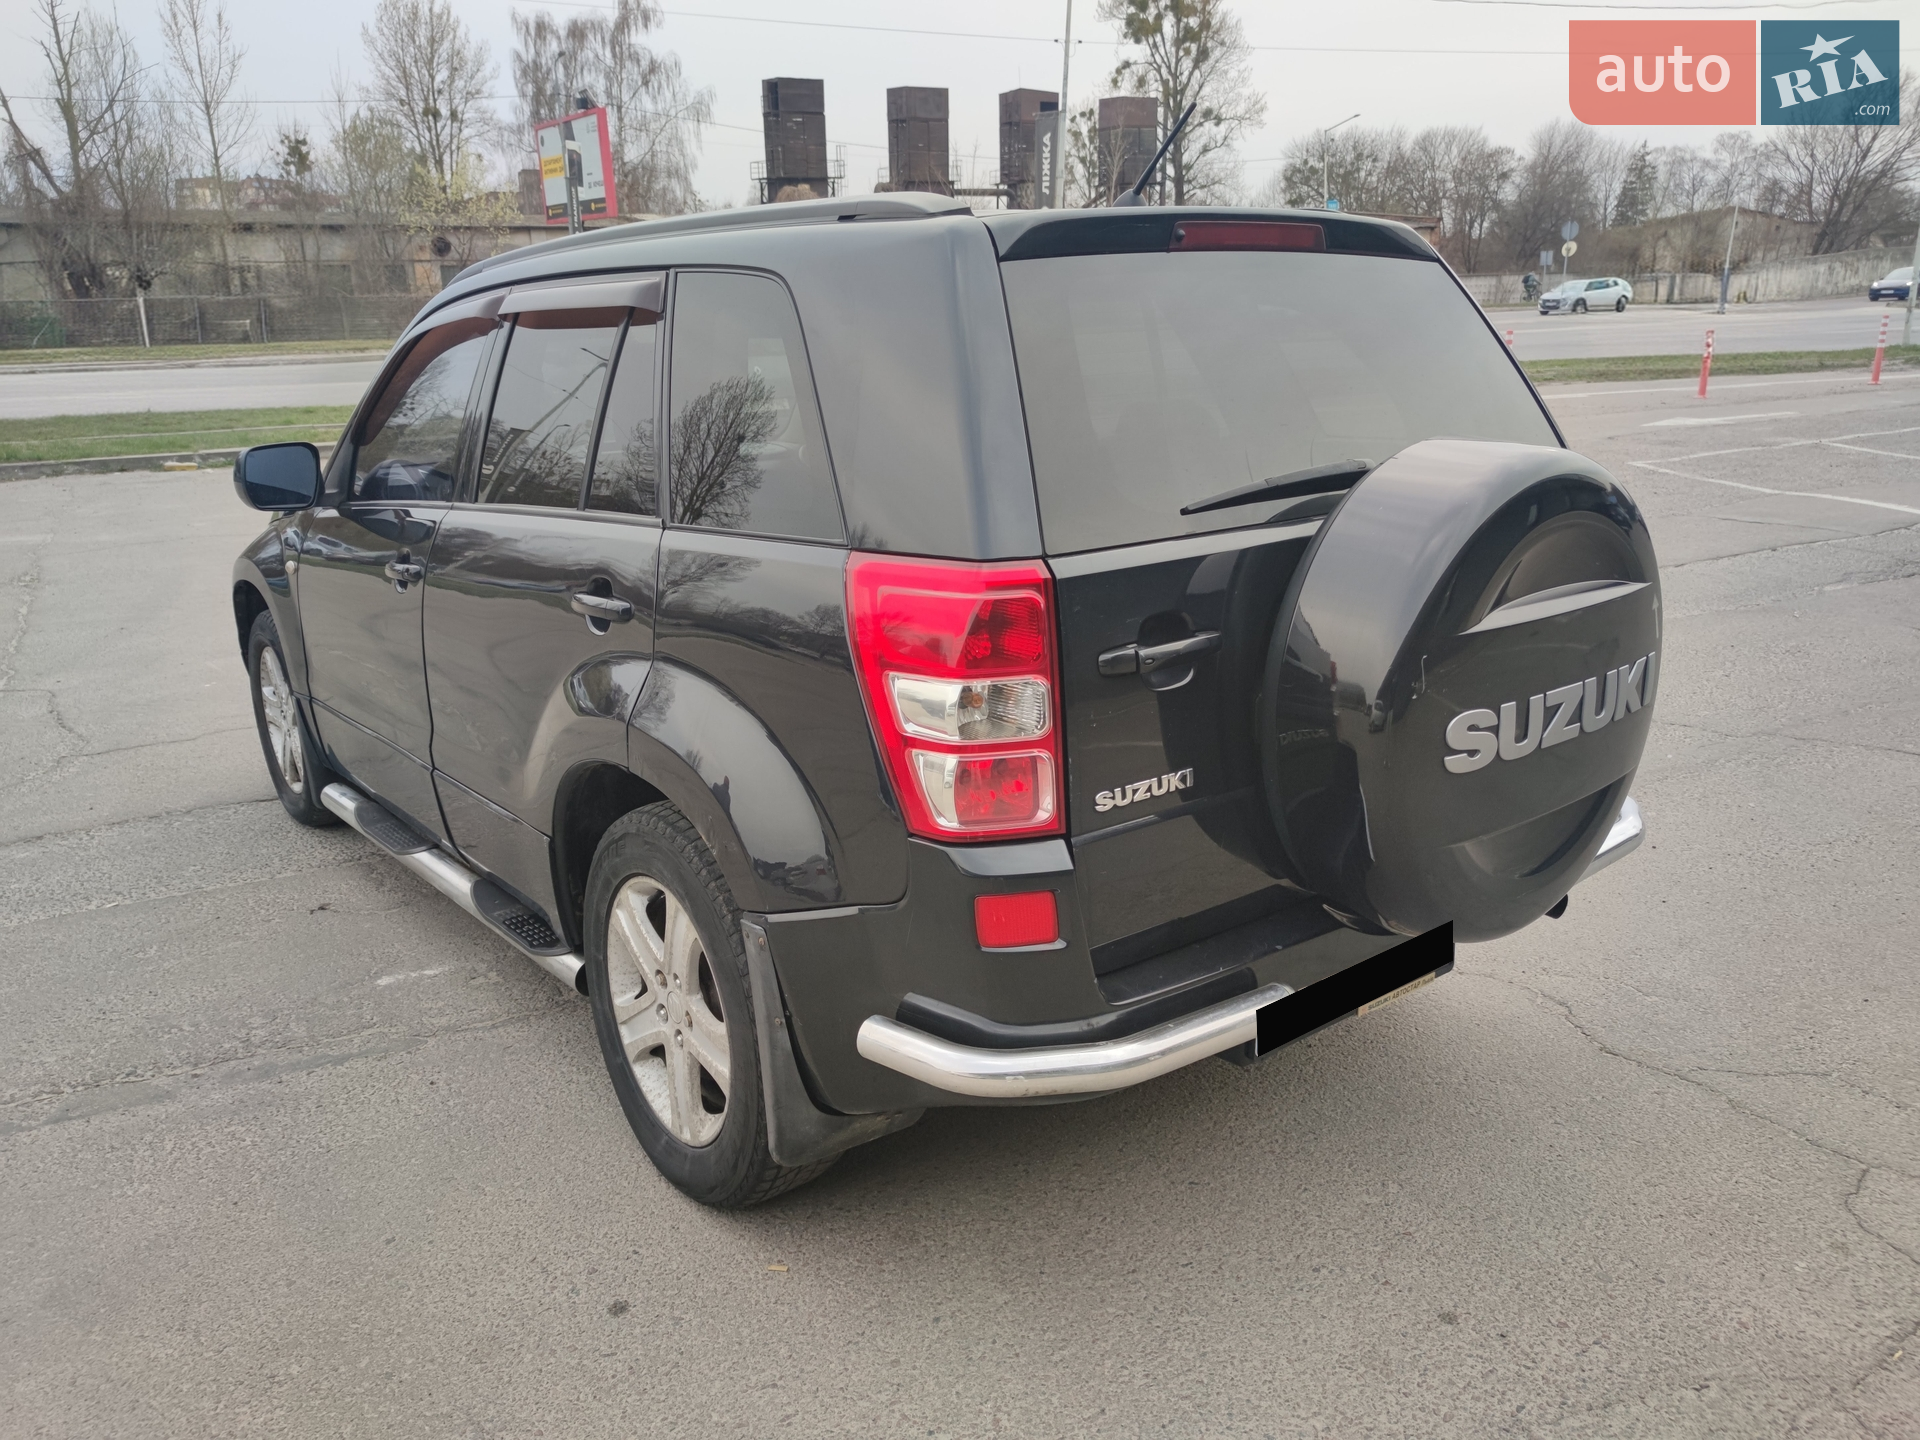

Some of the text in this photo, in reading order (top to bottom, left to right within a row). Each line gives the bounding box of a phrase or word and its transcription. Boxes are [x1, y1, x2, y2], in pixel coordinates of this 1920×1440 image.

[1042, 132, 1051, 195] ЛІЖКА
[1443, 651, 1656, 774] SUZUKI
[1094, 767, 1194, 812] SUZUKI
